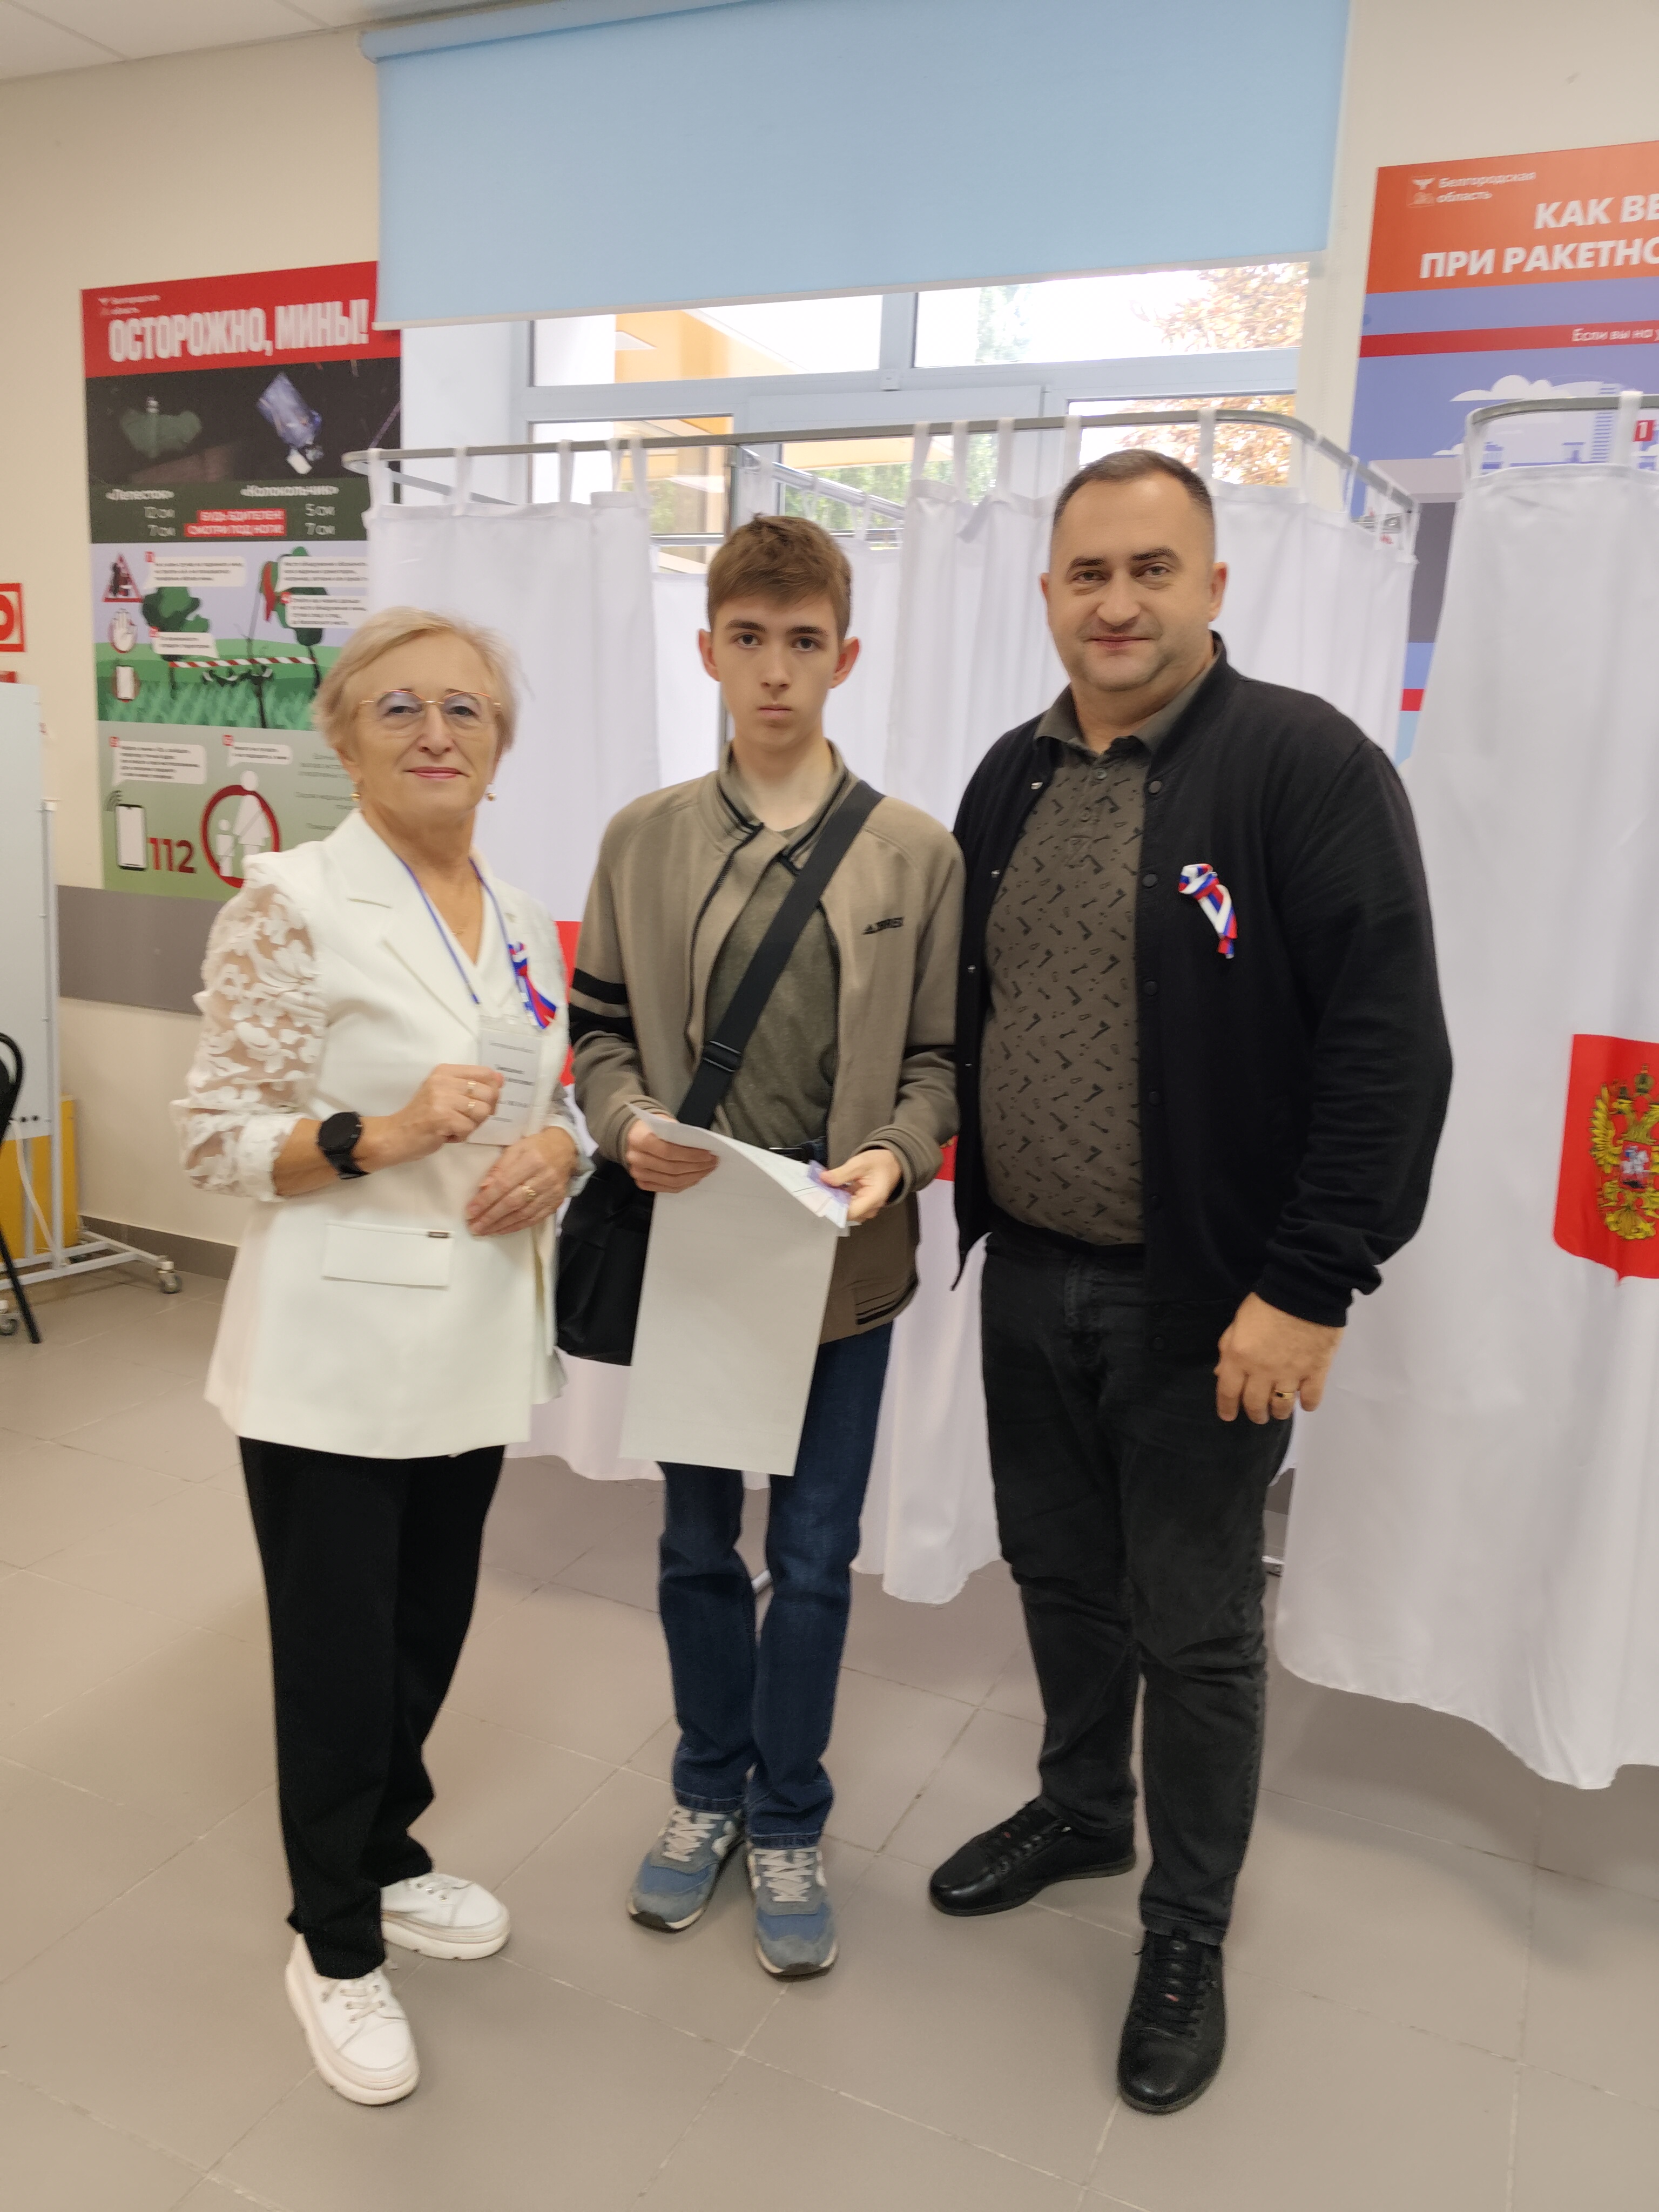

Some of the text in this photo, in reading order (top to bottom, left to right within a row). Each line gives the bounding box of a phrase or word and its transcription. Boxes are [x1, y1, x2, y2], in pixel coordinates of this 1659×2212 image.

[1534, 197, 1615, 229] КАК
[1419, 248, 1496, 279] ПРИ
[109, 299, 369, 362] ОСТОРОЖНО, МИНЫ!
[1572, 328, 1608, 342] Если
[1638, 422, 1648, 439] 1
[148, 838, 197, 874] 112
